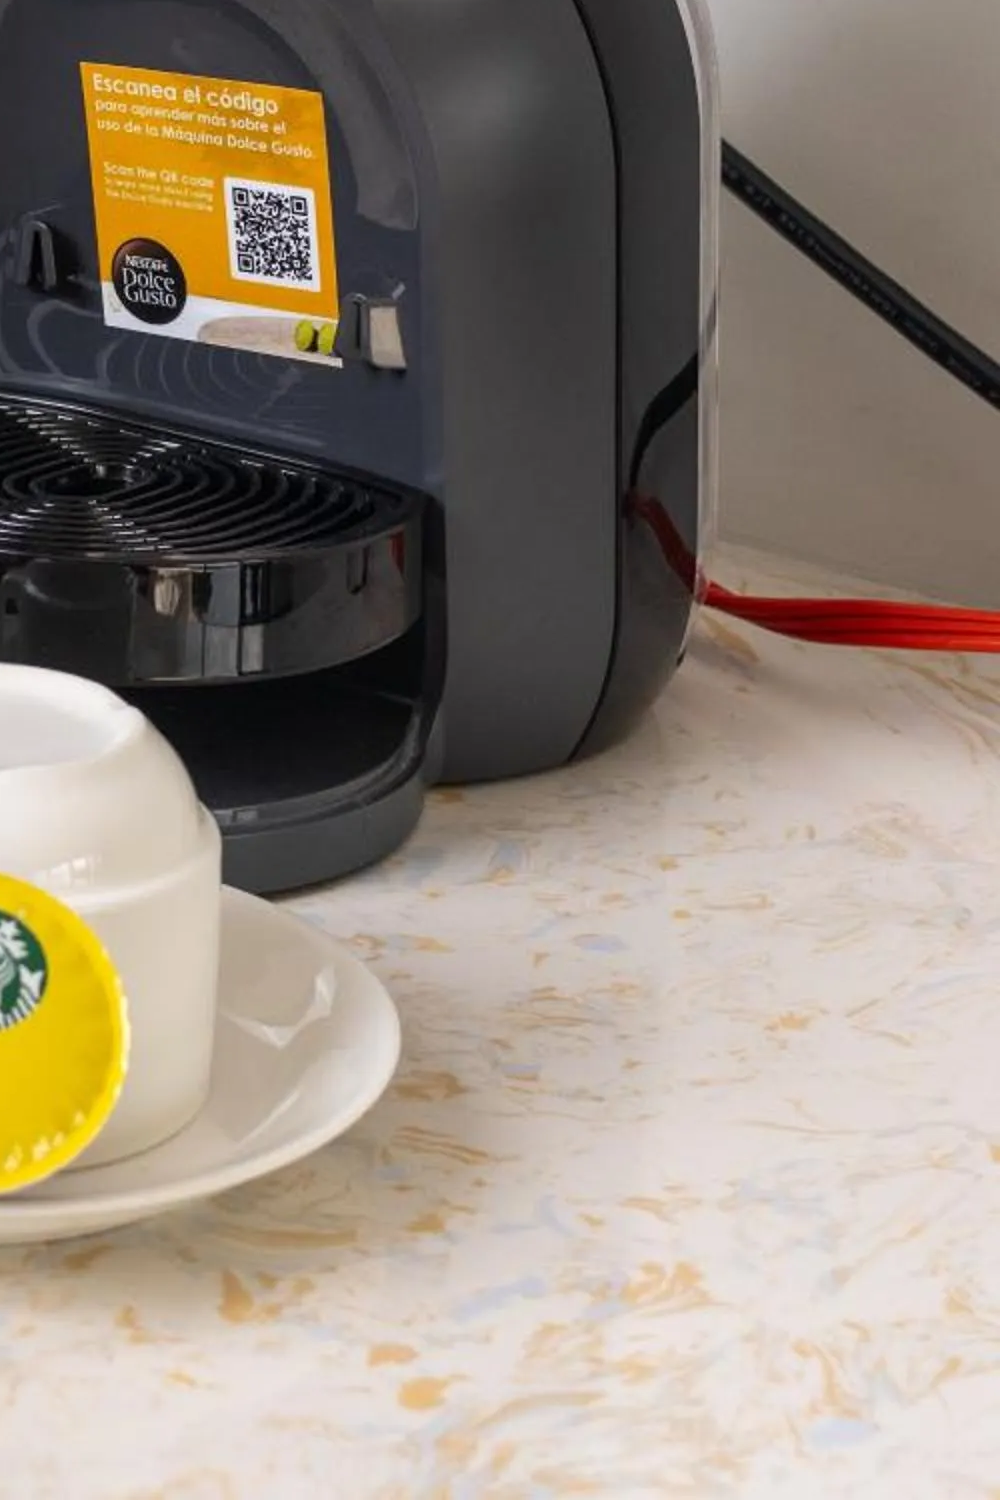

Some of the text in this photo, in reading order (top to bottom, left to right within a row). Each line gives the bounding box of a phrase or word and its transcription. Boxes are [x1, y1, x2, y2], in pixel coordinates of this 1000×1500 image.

[92, 73, 279, 117] Escanea el código
[95, 99, 286, 135] para aprender más sobre el
[97, 120, 121, 131] uso
[124, 119, 142, 133] de
[145, 123, 159, 136] la
[161, 124, 223, 146] Máquina
[227, 134, 268, 153] Dolce
[122, 267, 175, 292] Dolce
[124, 284, 177, 308] Gusto
